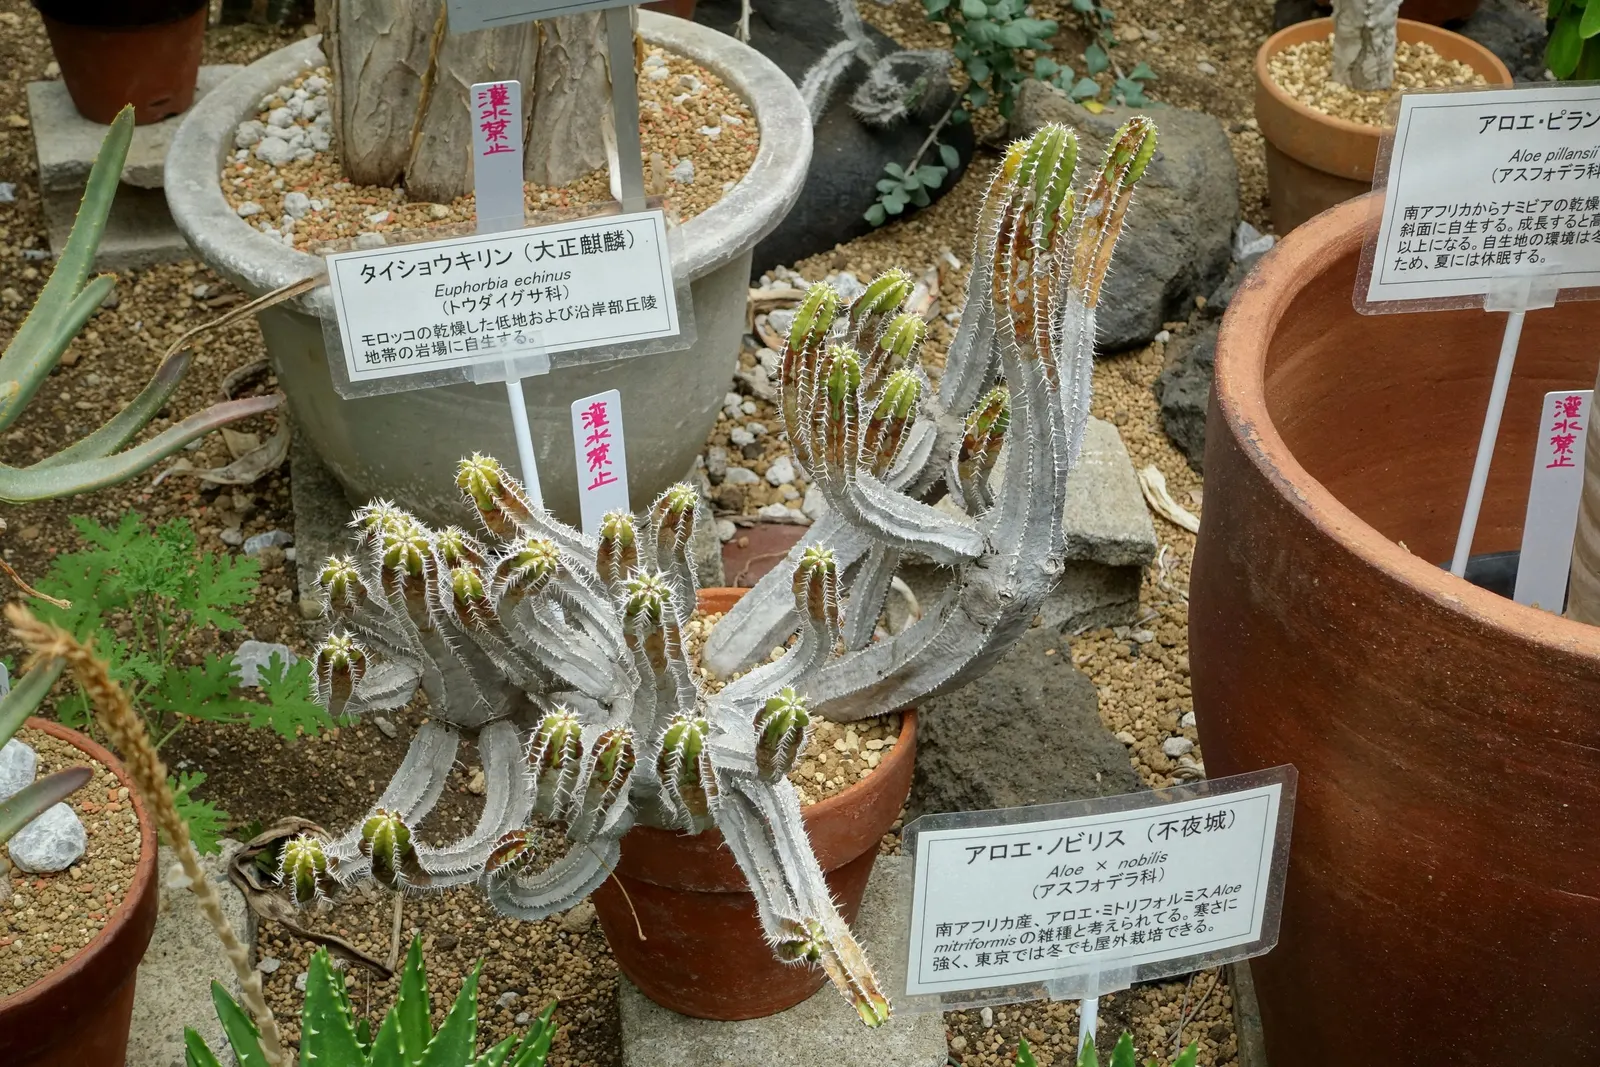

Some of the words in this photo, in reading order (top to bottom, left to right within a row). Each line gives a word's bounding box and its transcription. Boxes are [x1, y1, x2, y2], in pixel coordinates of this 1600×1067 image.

[1508, 149, 1541, 163] Aloe
[1544, 145, 1600, 164] pillansii
[1394, 249, 1546, 271] ため、夏には休眠する。
[434, 276, 508, 298] Euphorbia
[514, 270, 571, 287] echinus
[442, 284, 569, 316] （トウダイグサ科）
[361, 294, 658, 347] モロッコの乾燥した低地および沿岸部丘陵
[364, 330, 535, 365] 地帯の岩場に自生する。
[965, 829, 1126, 865] アロエ・ノビリス
[1147, 809, 1236, 843] （不夜城）
[1046, 864, 1084, 879] Aloe
[1118, 850, 1169, 870] nobilis
[1033, 867, 1165, 900] （アスフォデラ科）
[932, 919, 1214, 972] 強く、東京では冬でも屋外栽培できる。
